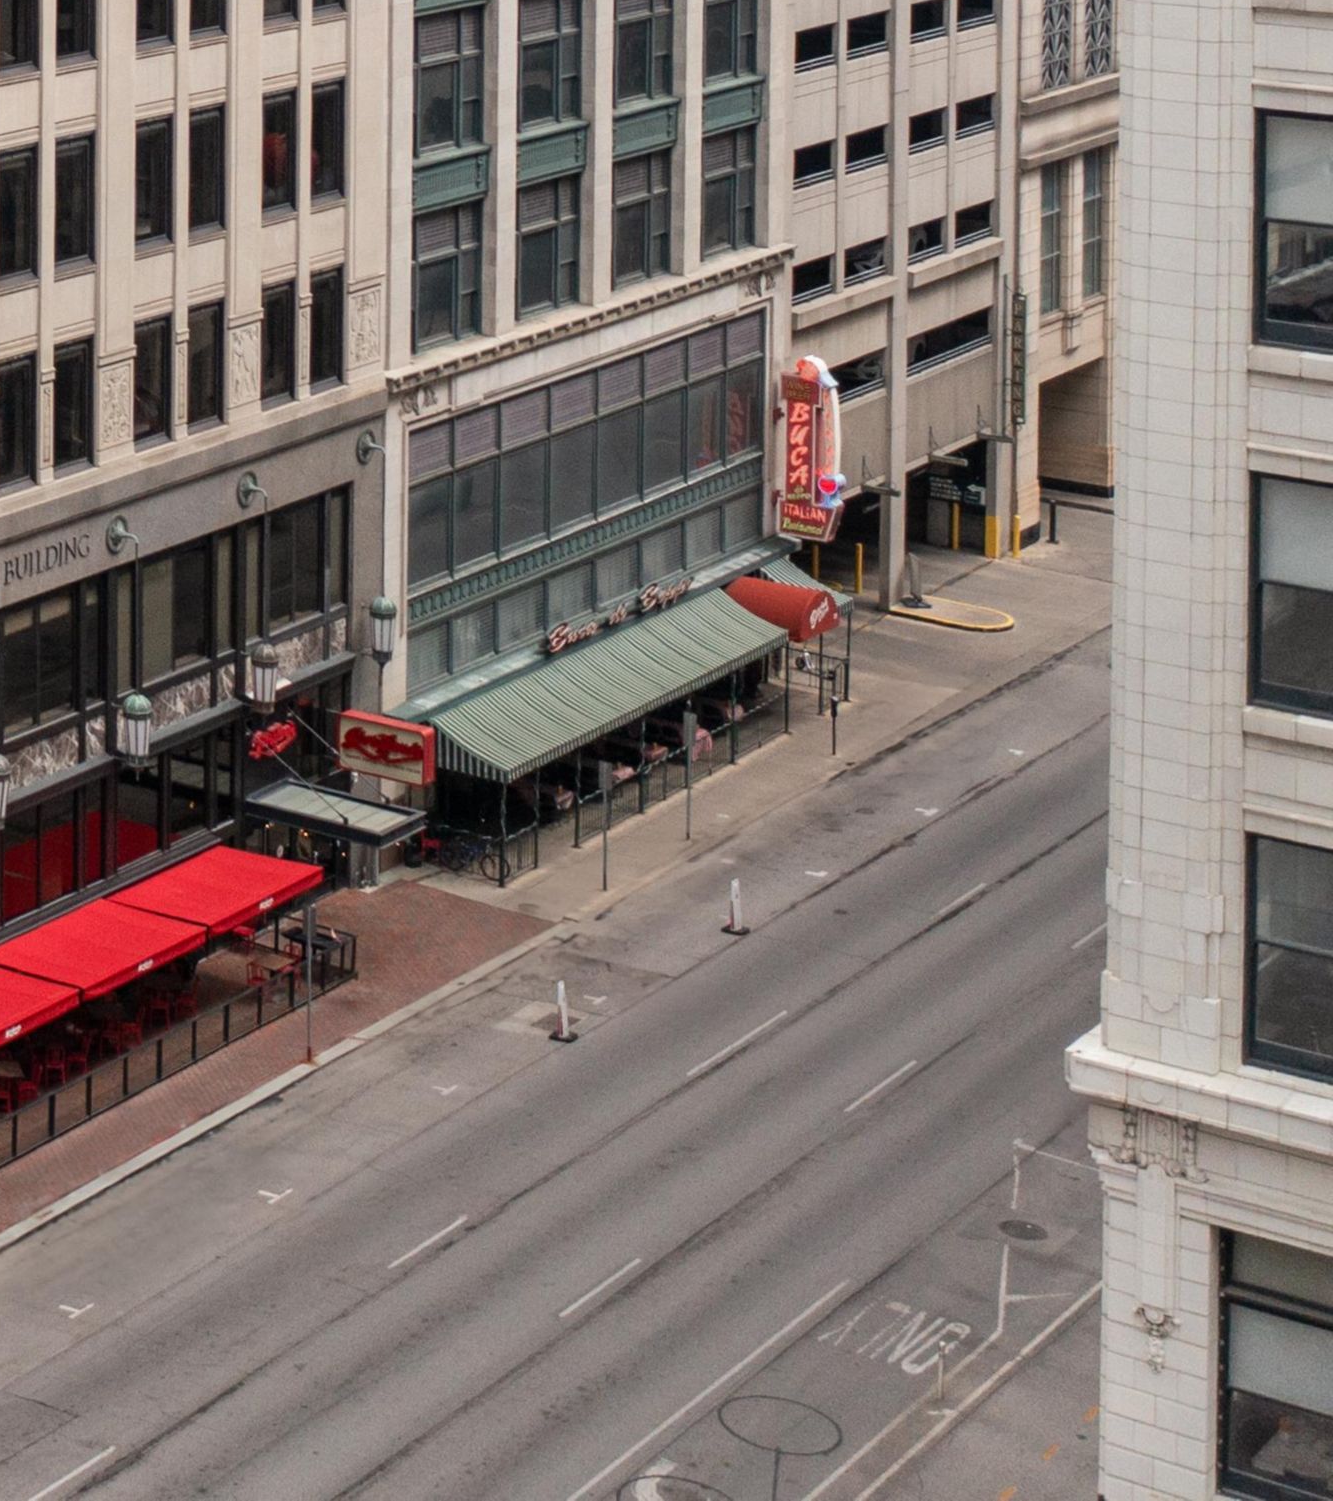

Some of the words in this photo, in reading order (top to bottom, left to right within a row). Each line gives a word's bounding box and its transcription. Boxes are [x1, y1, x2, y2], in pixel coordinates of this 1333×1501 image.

[1013, 302, 1023, 415] PARKING
[789, 402, 810, 486] BUCA
[3, 534, 91, 586] BUILDING
